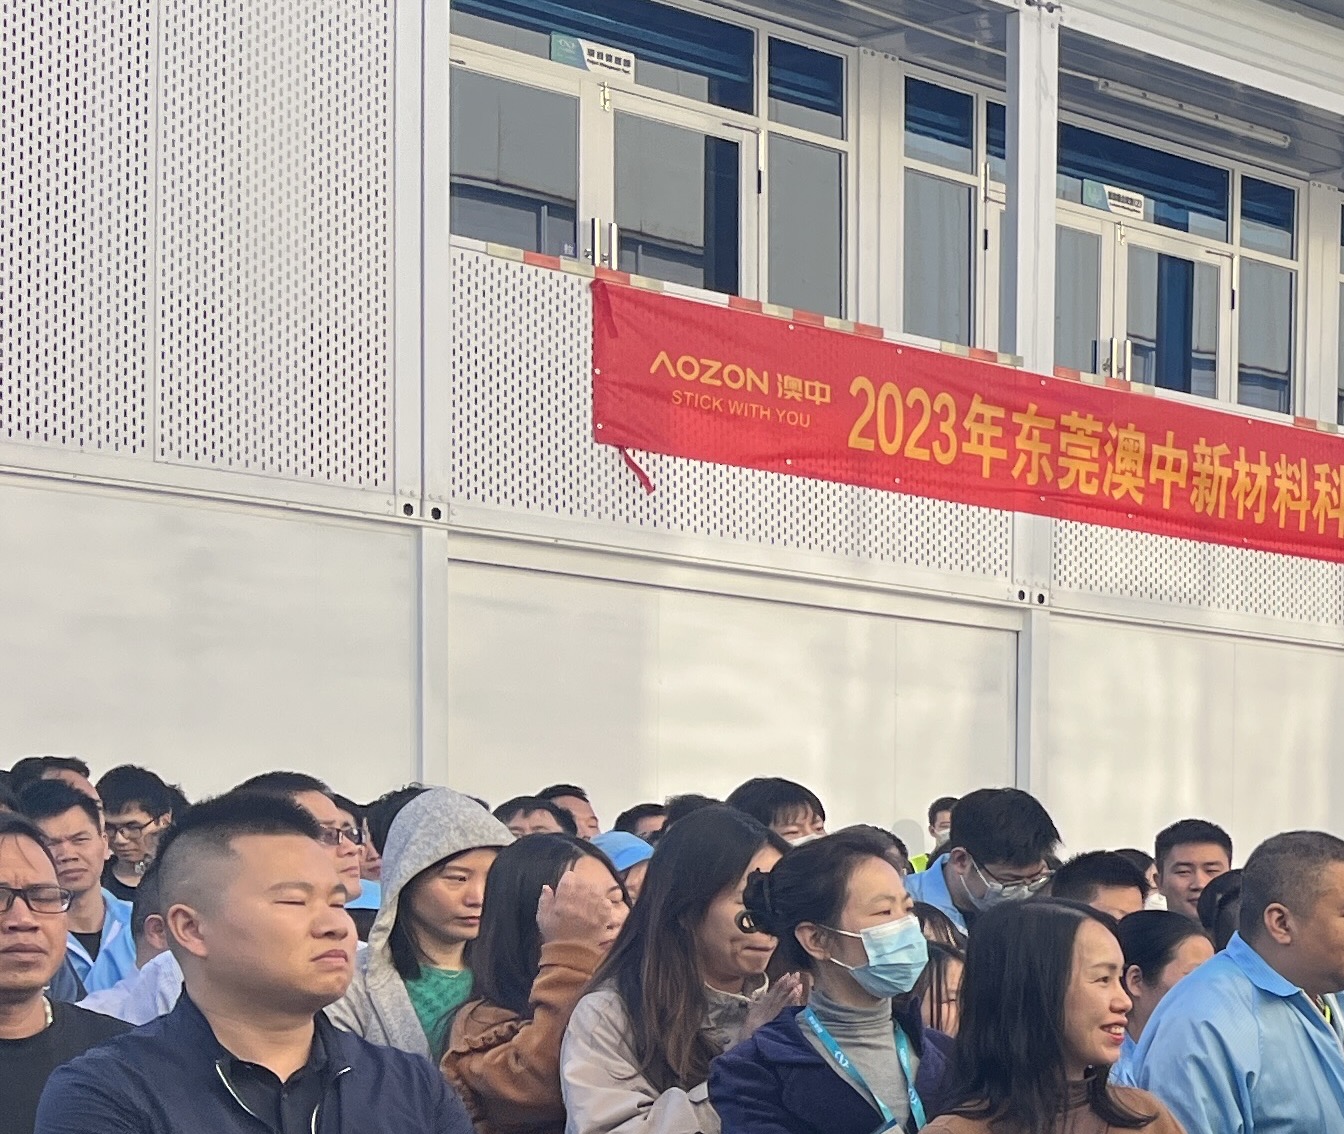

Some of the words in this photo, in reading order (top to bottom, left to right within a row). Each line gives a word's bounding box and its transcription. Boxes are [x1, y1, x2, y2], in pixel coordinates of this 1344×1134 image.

[777, 373, 831, 405] 澳中
[672, 390, 723, 413] STICK
[728, 400, 771, 421] WITH
[776, 408, 811, 428] YOU
